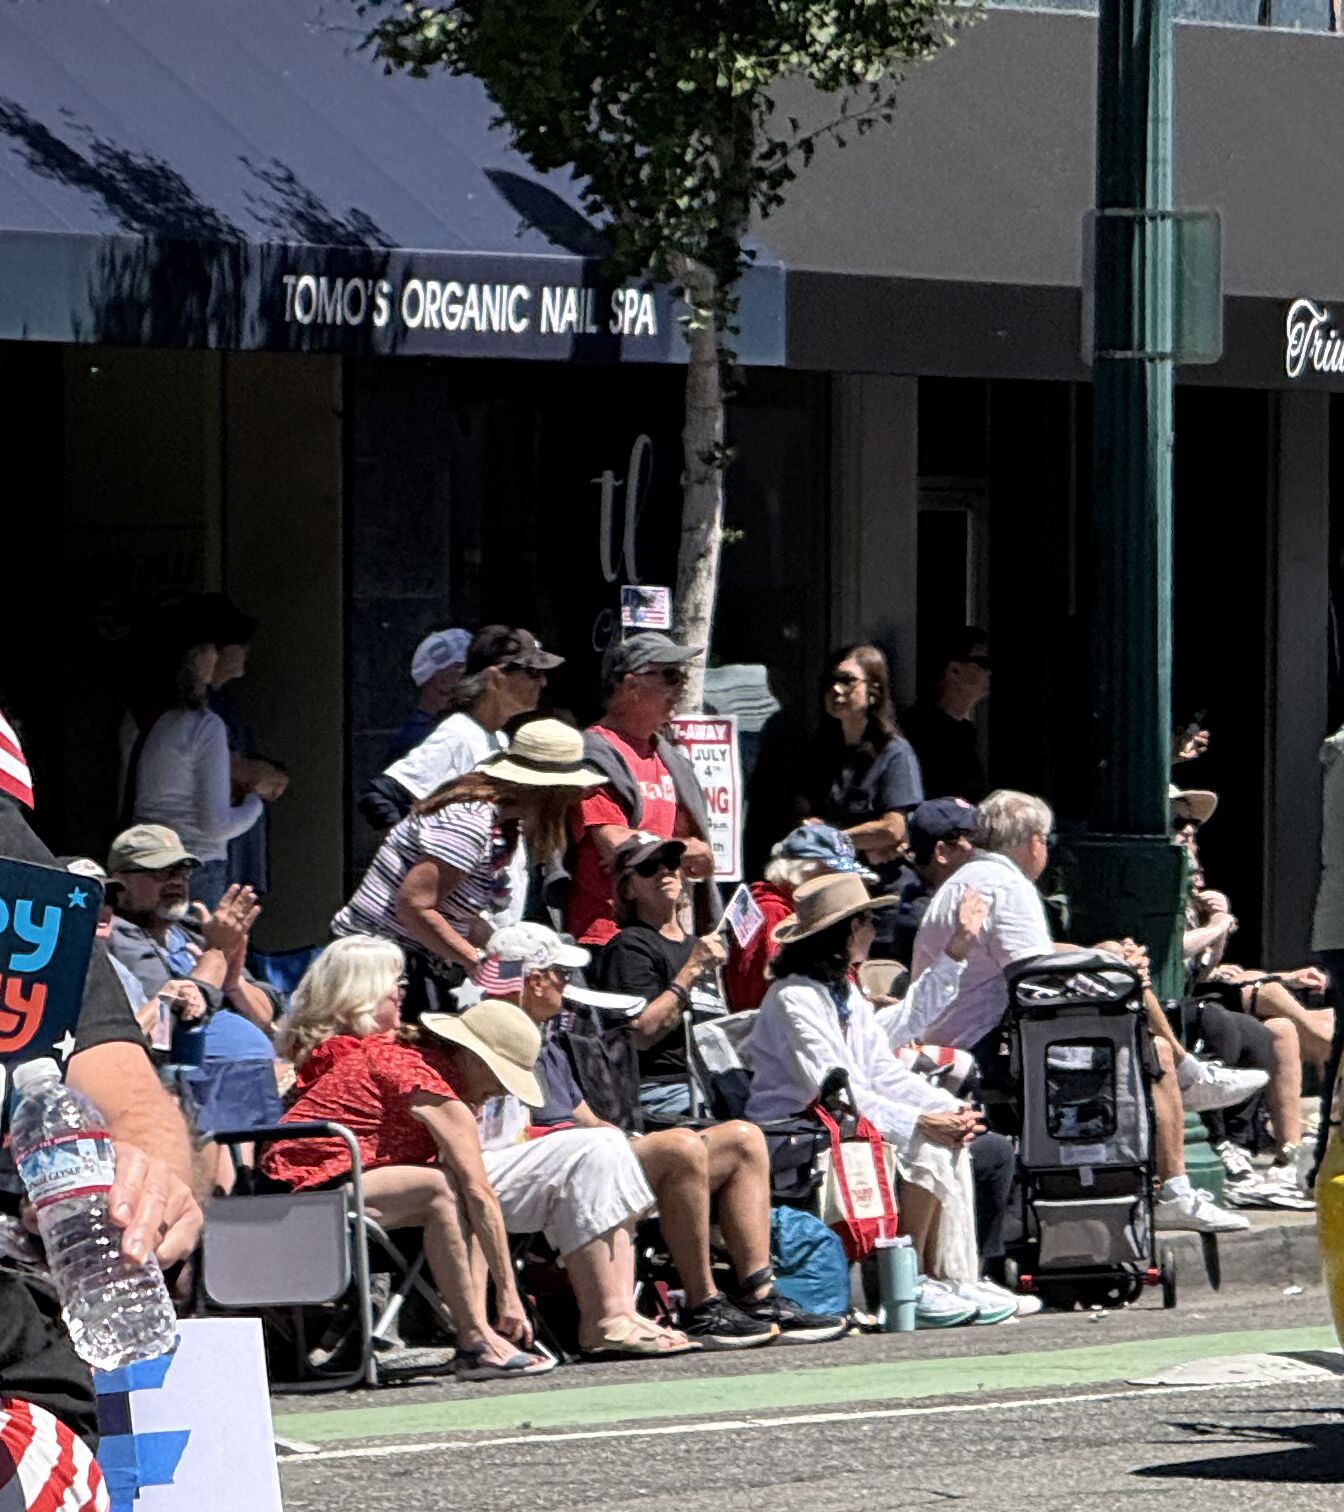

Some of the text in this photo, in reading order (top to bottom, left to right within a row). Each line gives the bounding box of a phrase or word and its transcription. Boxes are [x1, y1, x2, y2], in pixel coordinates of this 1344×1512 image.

[283, 275, 657, 336] TOMO'S ORGANIC NAIL SPA
[694, 747, 728, 763] JULY
